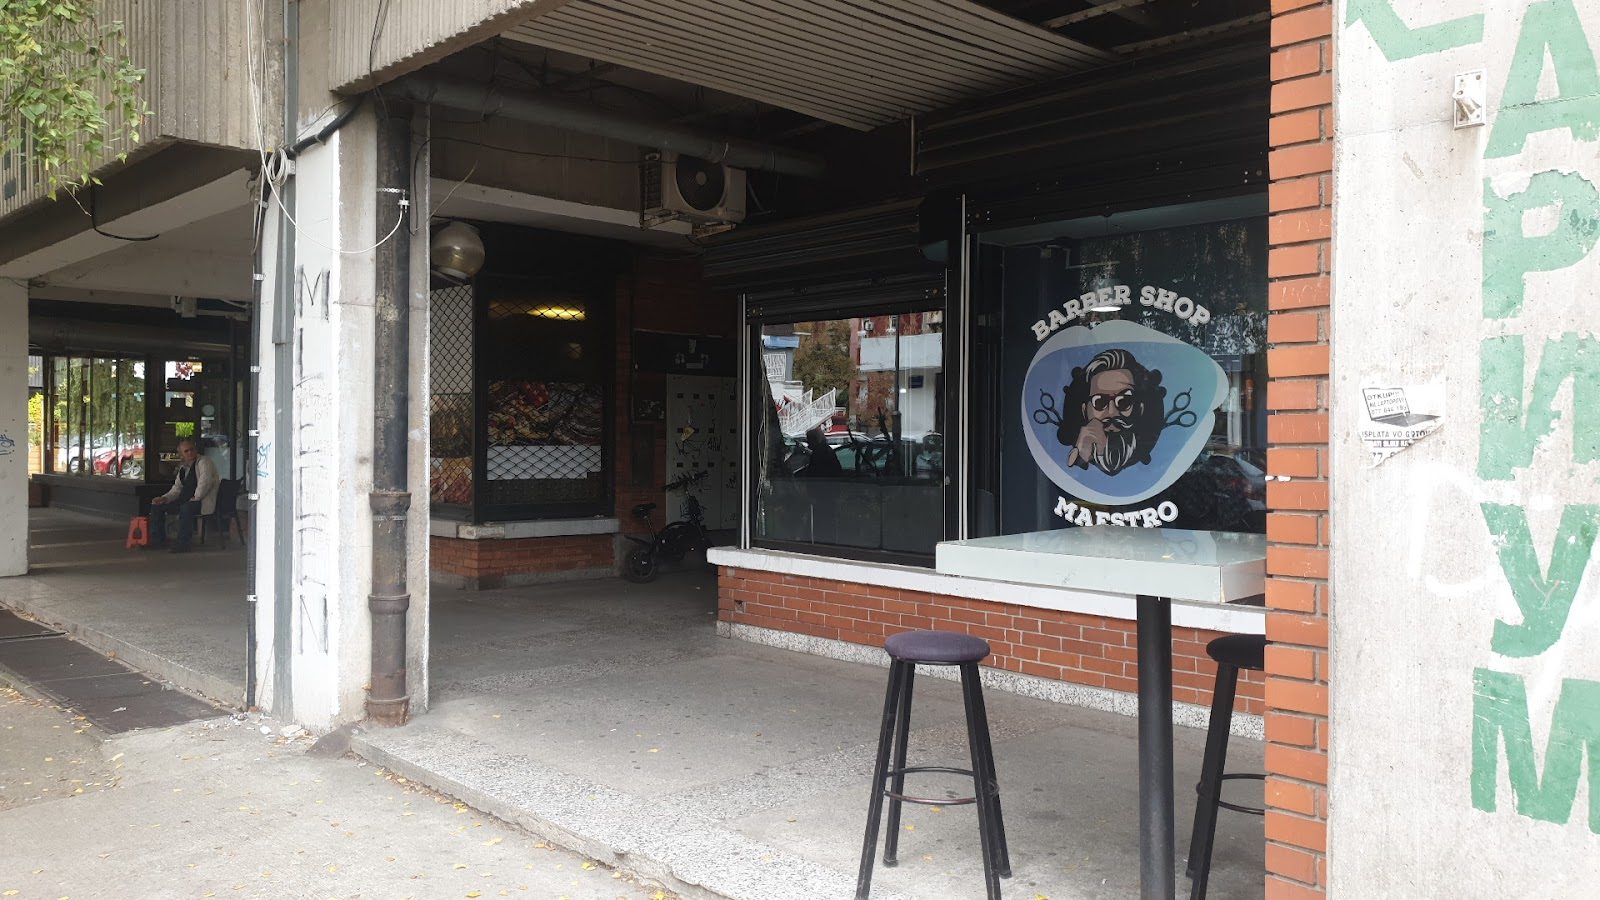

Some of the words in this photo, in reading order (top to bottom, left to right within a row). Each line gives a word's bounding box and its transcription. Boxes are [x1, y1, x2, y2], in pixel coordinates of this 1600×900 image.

[1031, 285, 1131, 342] BARBER
[1140, 285, 1211, 328] SHOP
[1392, 430, 1403, 438] VO
[1054, 496, 1179, 528] MAESTRO
